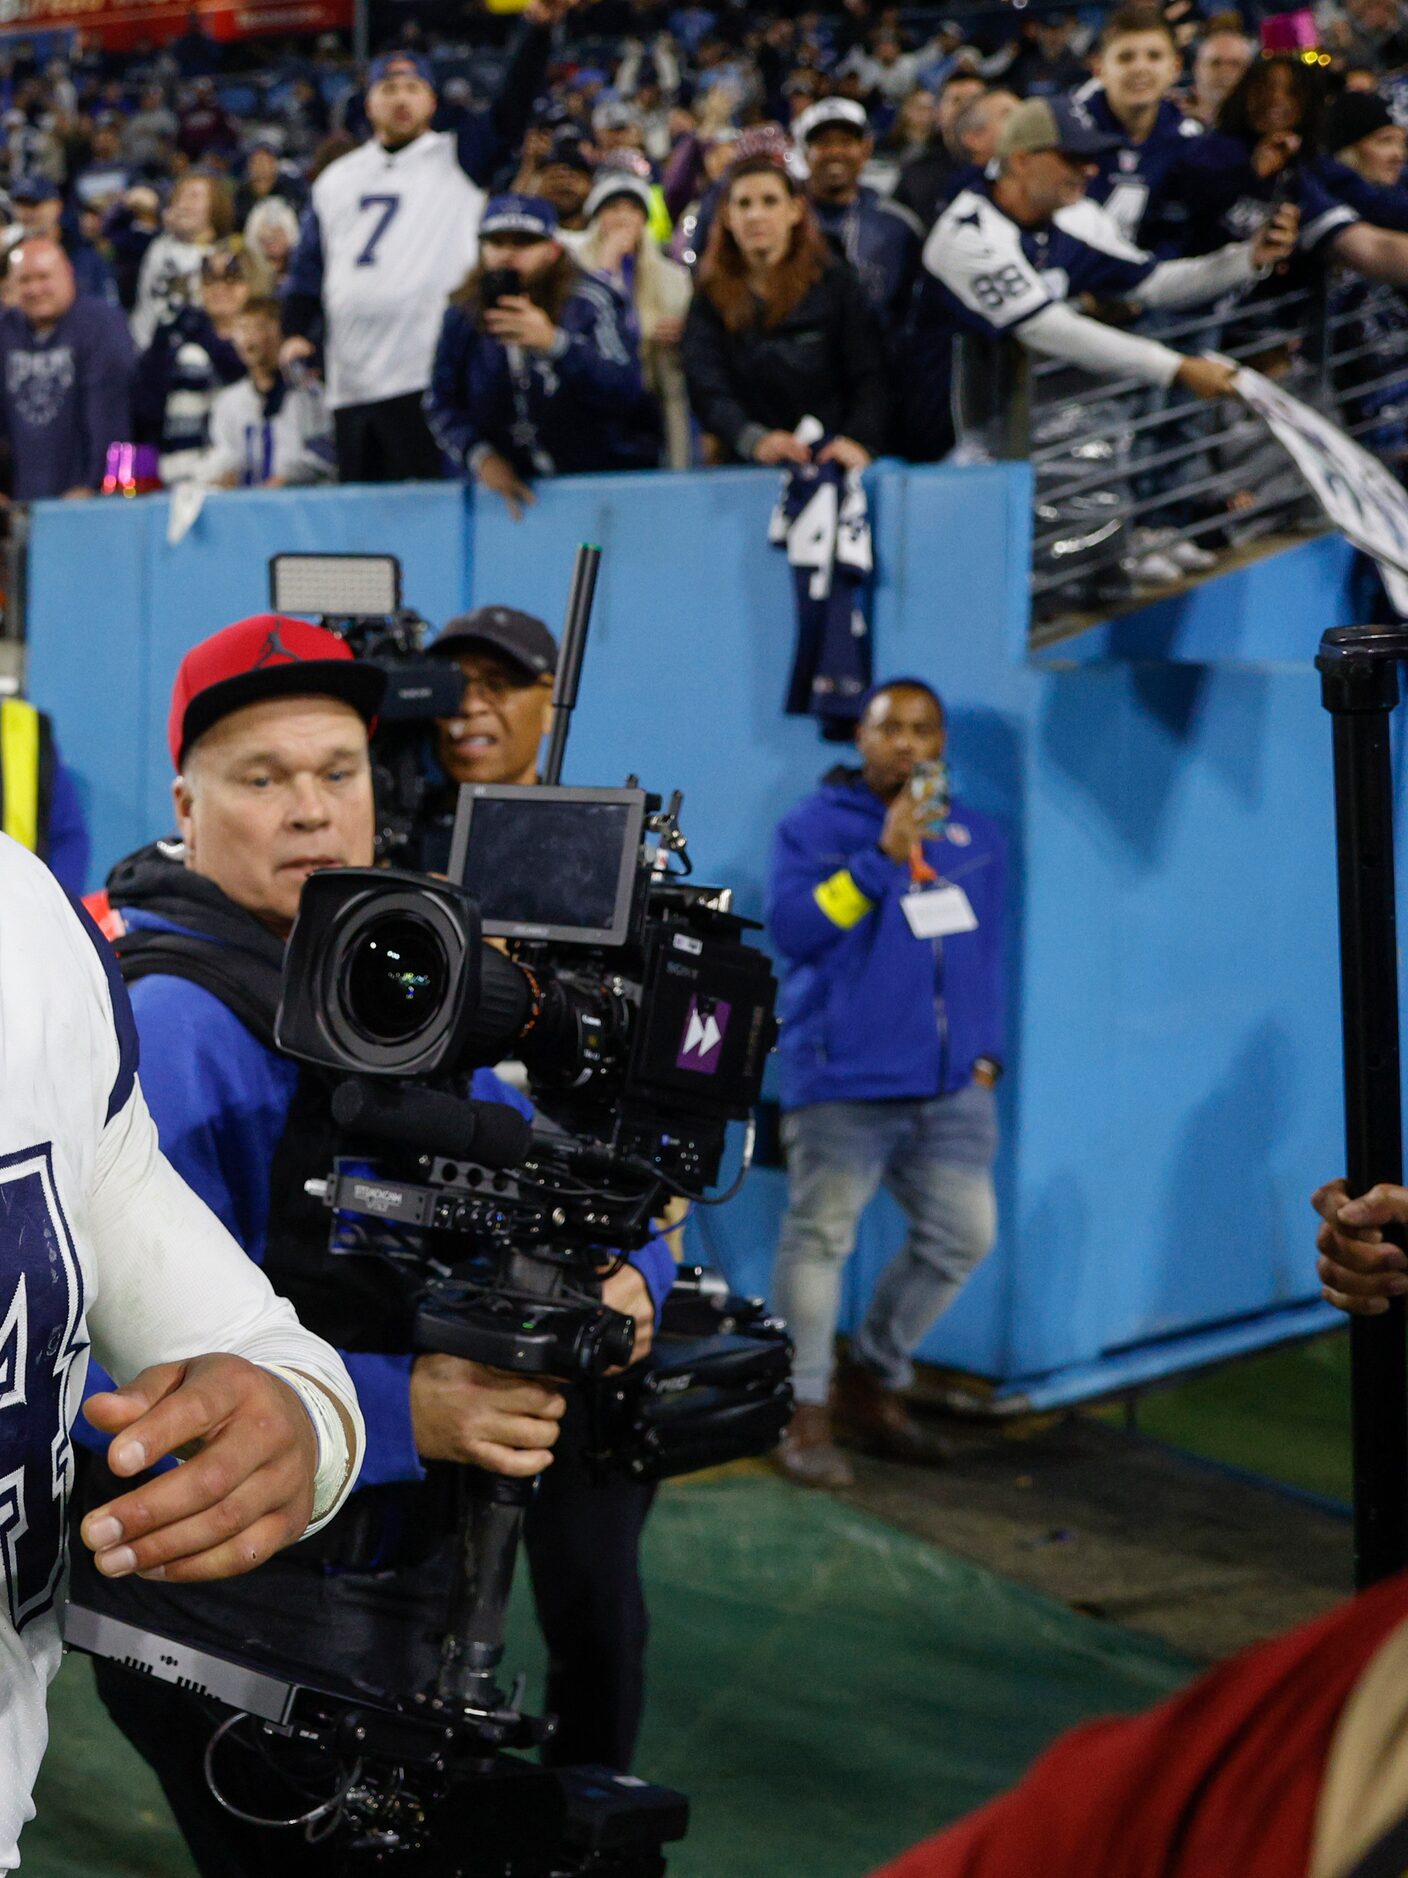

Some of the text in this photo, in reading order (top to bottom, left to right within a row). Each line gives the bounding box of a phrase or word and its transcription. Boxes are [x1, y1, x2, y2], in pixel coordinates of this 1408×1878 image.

[356, 194, 400, 267] 7
[973, 263, 1031, 311] 88
[787, 482, 839, 601] 4
